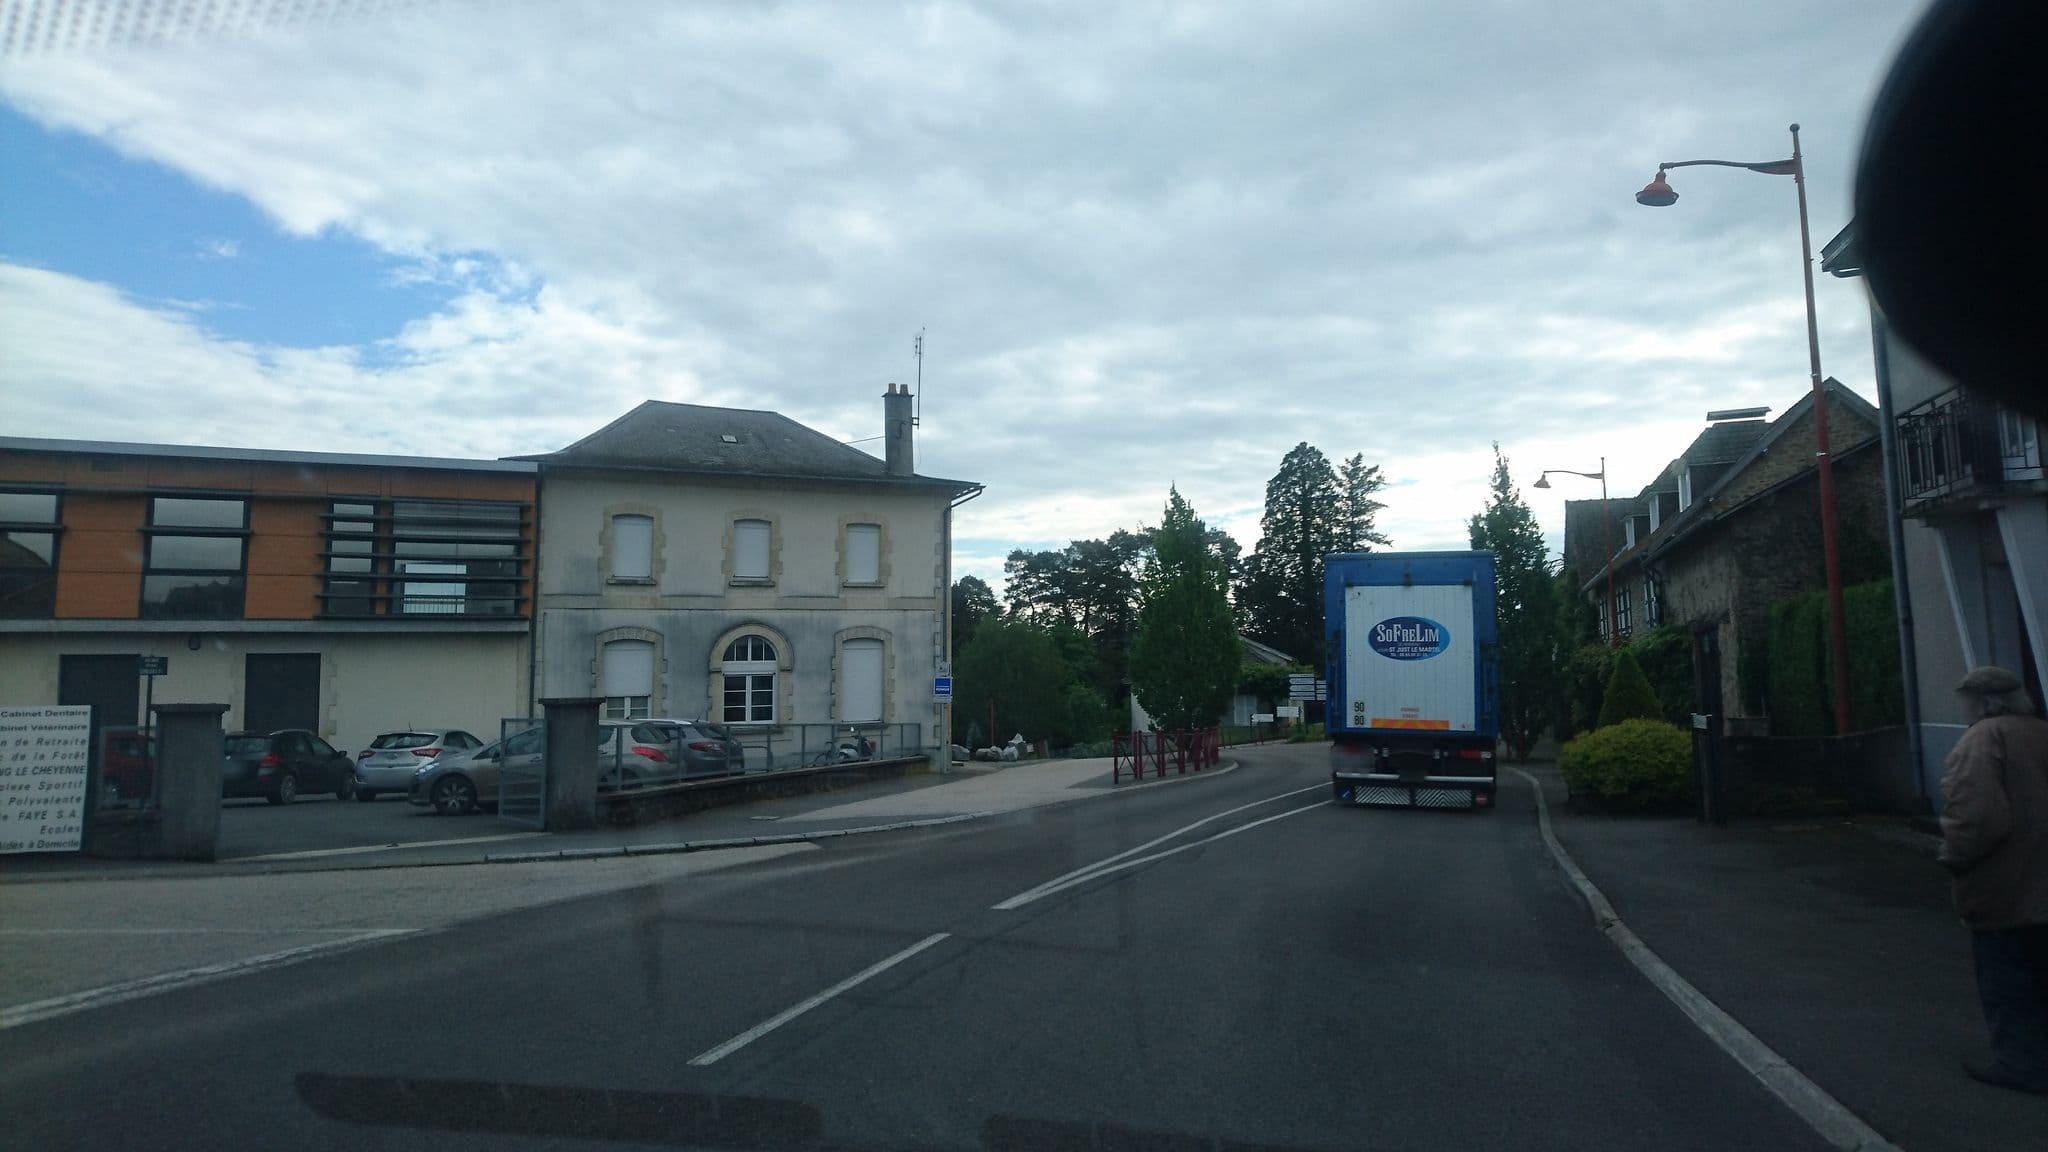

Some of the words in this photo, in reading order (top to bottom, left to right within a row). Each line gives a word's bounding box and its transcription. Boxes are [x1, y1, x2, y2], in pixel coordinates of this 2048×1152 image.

[1354, 701, 1365, 712] 90
[1, 710, 42, 718] Cabinet
[45, 709, 88, 717] Dentaire
[1354, 715, 1365, 726] 80
[15, 738, 28, 747] de
[36, 737, 87, 746] Retraite
[11, 752, 26, 761] de
[33, 751, 45, 761] la
[52, 751, 85, 760] Forêt
[15, 767, 29, 776] LE
[32, 765, 87, 775] CHEYENNE
[38, 780, 83, 792] Sportif
[8, 796, 82, 807] Polyvalente
[18, 810, 48, 821] FAYE
[40, 824, 80, 835] Ecoles
[37, 838, 80, 849] Domicile
